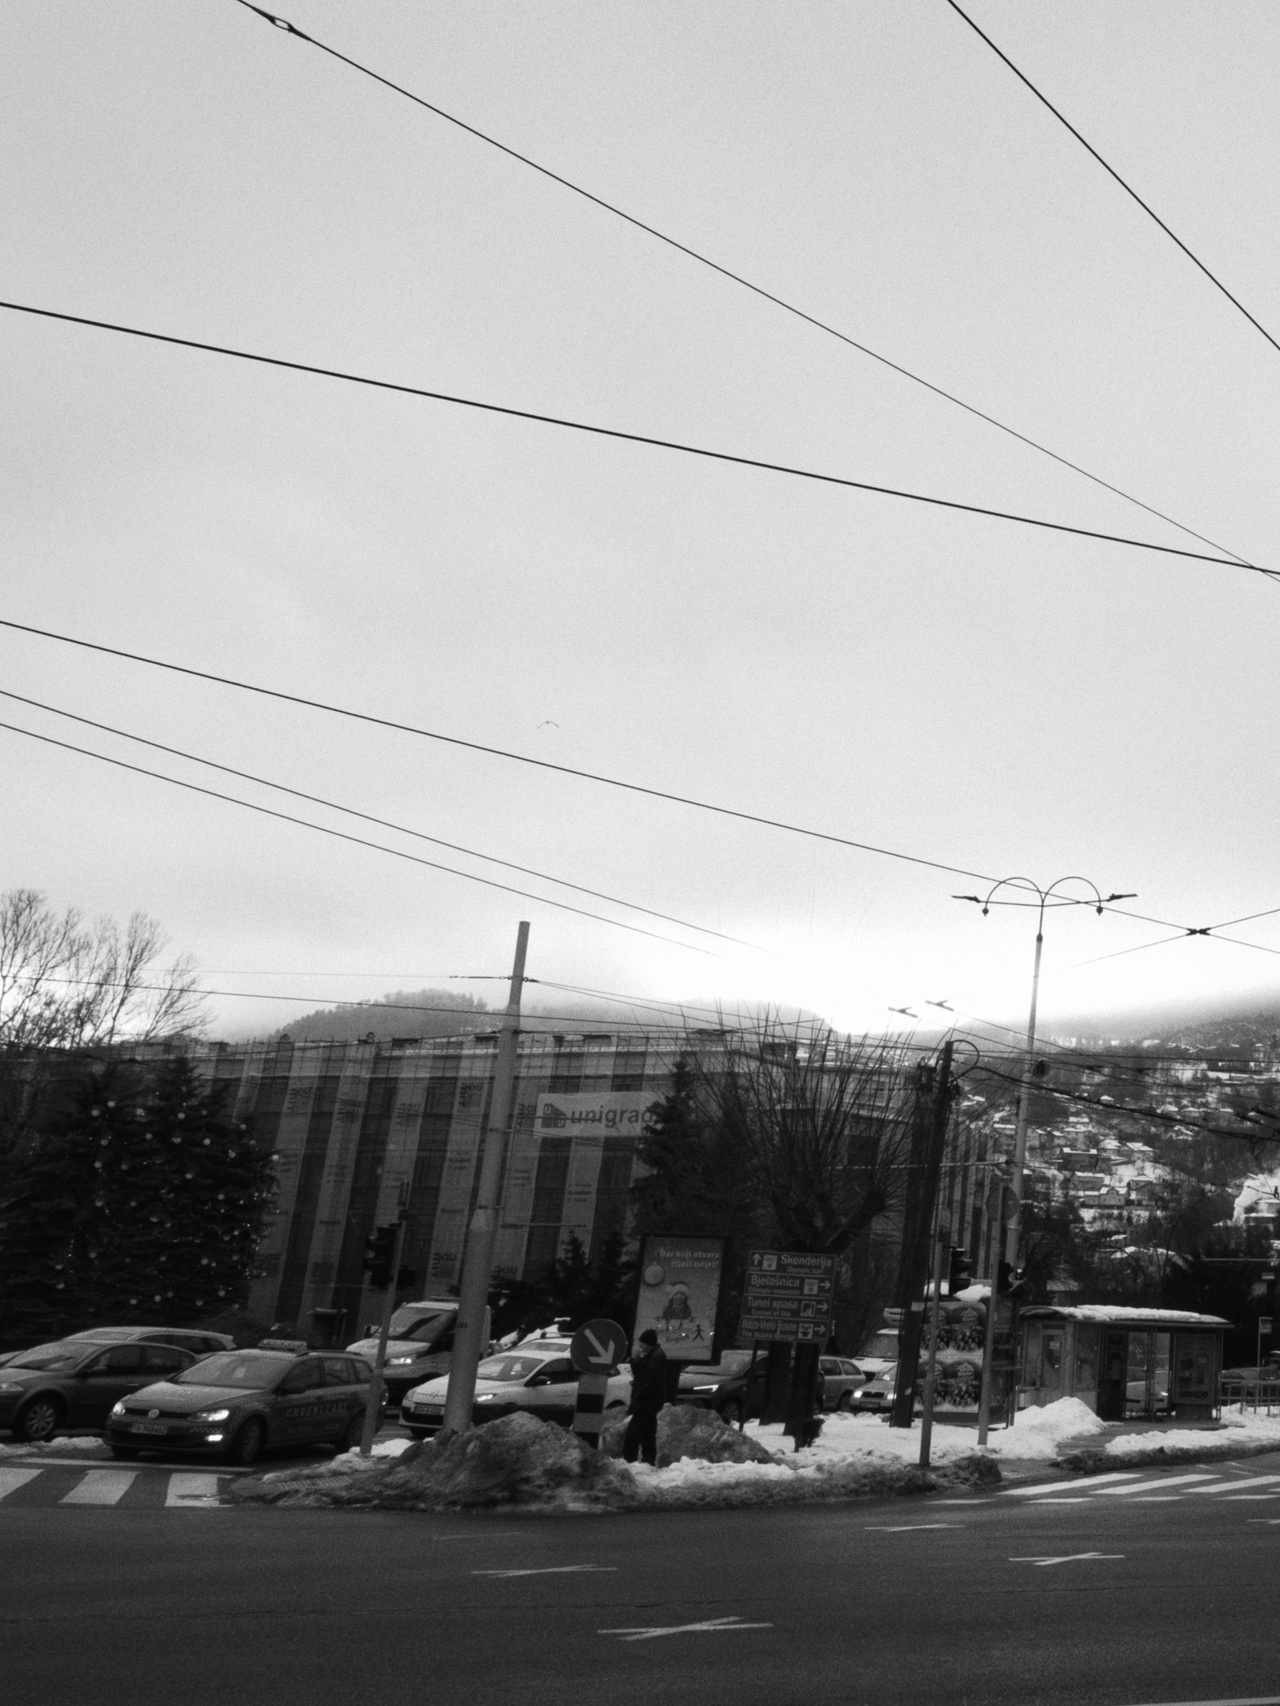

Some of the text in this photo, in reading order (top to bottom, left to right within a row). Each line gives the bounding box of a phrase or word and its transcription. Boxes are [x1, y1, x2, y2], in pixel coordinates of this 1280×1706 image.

[780, 1254, 832, 1268] Skenderija
[750, 1274, 800, 1287] Bjelašnica
[747, 1296, 798, 1310] Tunel spasa
